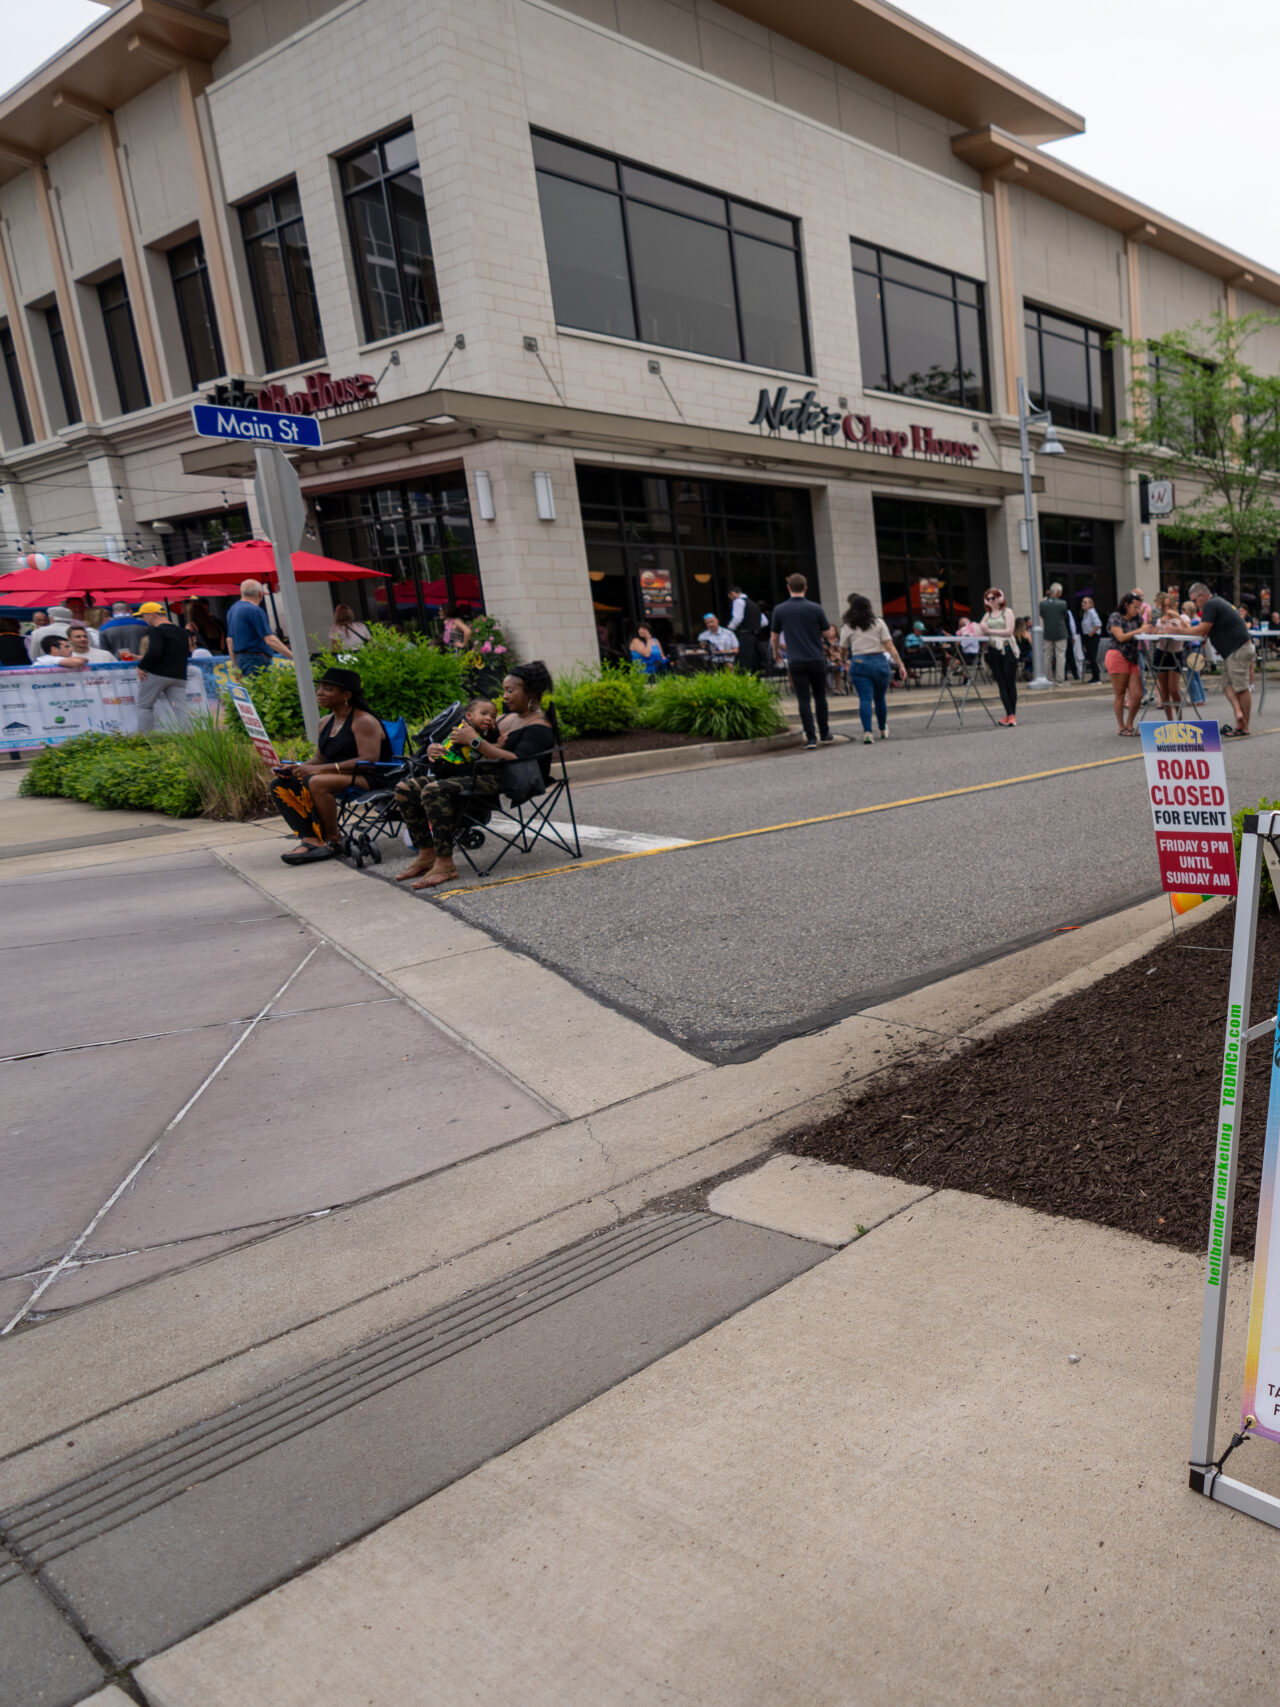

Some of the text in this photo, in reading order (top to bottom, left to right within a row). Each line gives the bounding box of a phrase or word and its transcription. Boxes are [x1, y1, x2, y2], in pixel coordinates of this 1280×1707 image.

[303, 371, 377, 411] House
[217, 411, 299, 441] Main St
[748, 386, 979, 461] Nate's Chop House
[1153, 722, 1204, 744] SUNSET
[1157, 743, 1205, 752] MUSIC FESTIVAL
[1157, 759, 1210, 780] ROAD
[1151, 785, 1225, 806] CLOSED
[1155, 810, 1226, 826] FOR EVENT
[1160, 839, 1229, 853] FRIDAY 9 PM
[1179, 855, 1213, 869] UNTIL
[1166, 871, 1230, 886] SUNDAY AM
[1207, 1003, 1242, 1286] hellbender marketing TBDMCo.com
